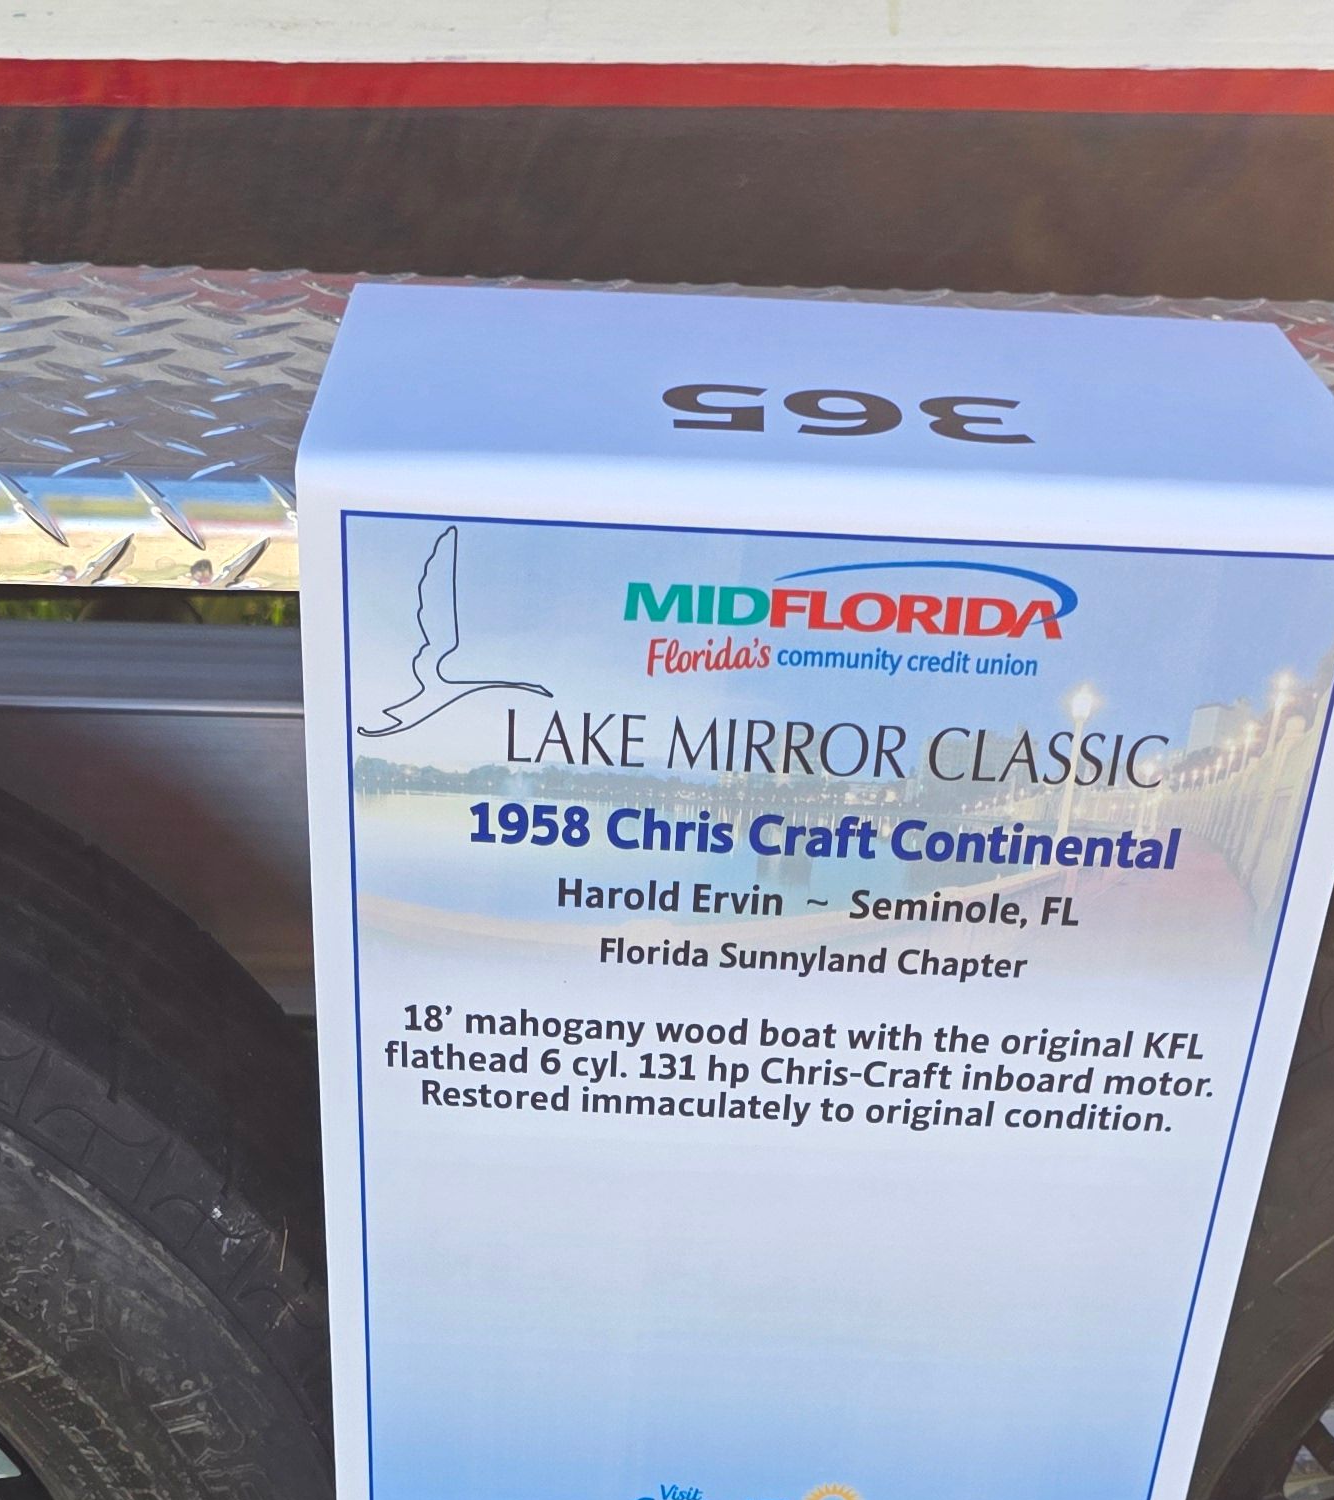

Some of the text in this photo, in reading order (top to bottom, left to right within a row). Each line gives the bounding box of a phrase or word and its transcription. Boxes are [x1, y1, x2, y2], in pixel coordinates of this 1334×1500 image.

[661, 383, 1036, 445] 365
[623, 581, 1064, 640] MIDFLORIDA
[646, 635, 1038, 678] Florida's community credit union
[507, 708, 1170, 789] LAKE MIRROR CLASSIC
[470, 802, 1181, 870] 1958 Chris Craft Continental
[557, 877, 680, 912] Harold
[692, 883, 783, 916] Ervin
[849, 889, 1028, 929] Seminole,
[1040, 896, 1079, 927] FL
[600, 937, 1028, 983] Florida Sunnyland Chapter
[404, 1004, 1204, 1063] 18' mahogany wood boat with the original KFL
[384, 1040, 1213, 1098] flathead 6 cyl. 131 hp Chris-Craft inboard motor.
[421, 1079, 1172, 1133] Restored immaculately to original condition.
